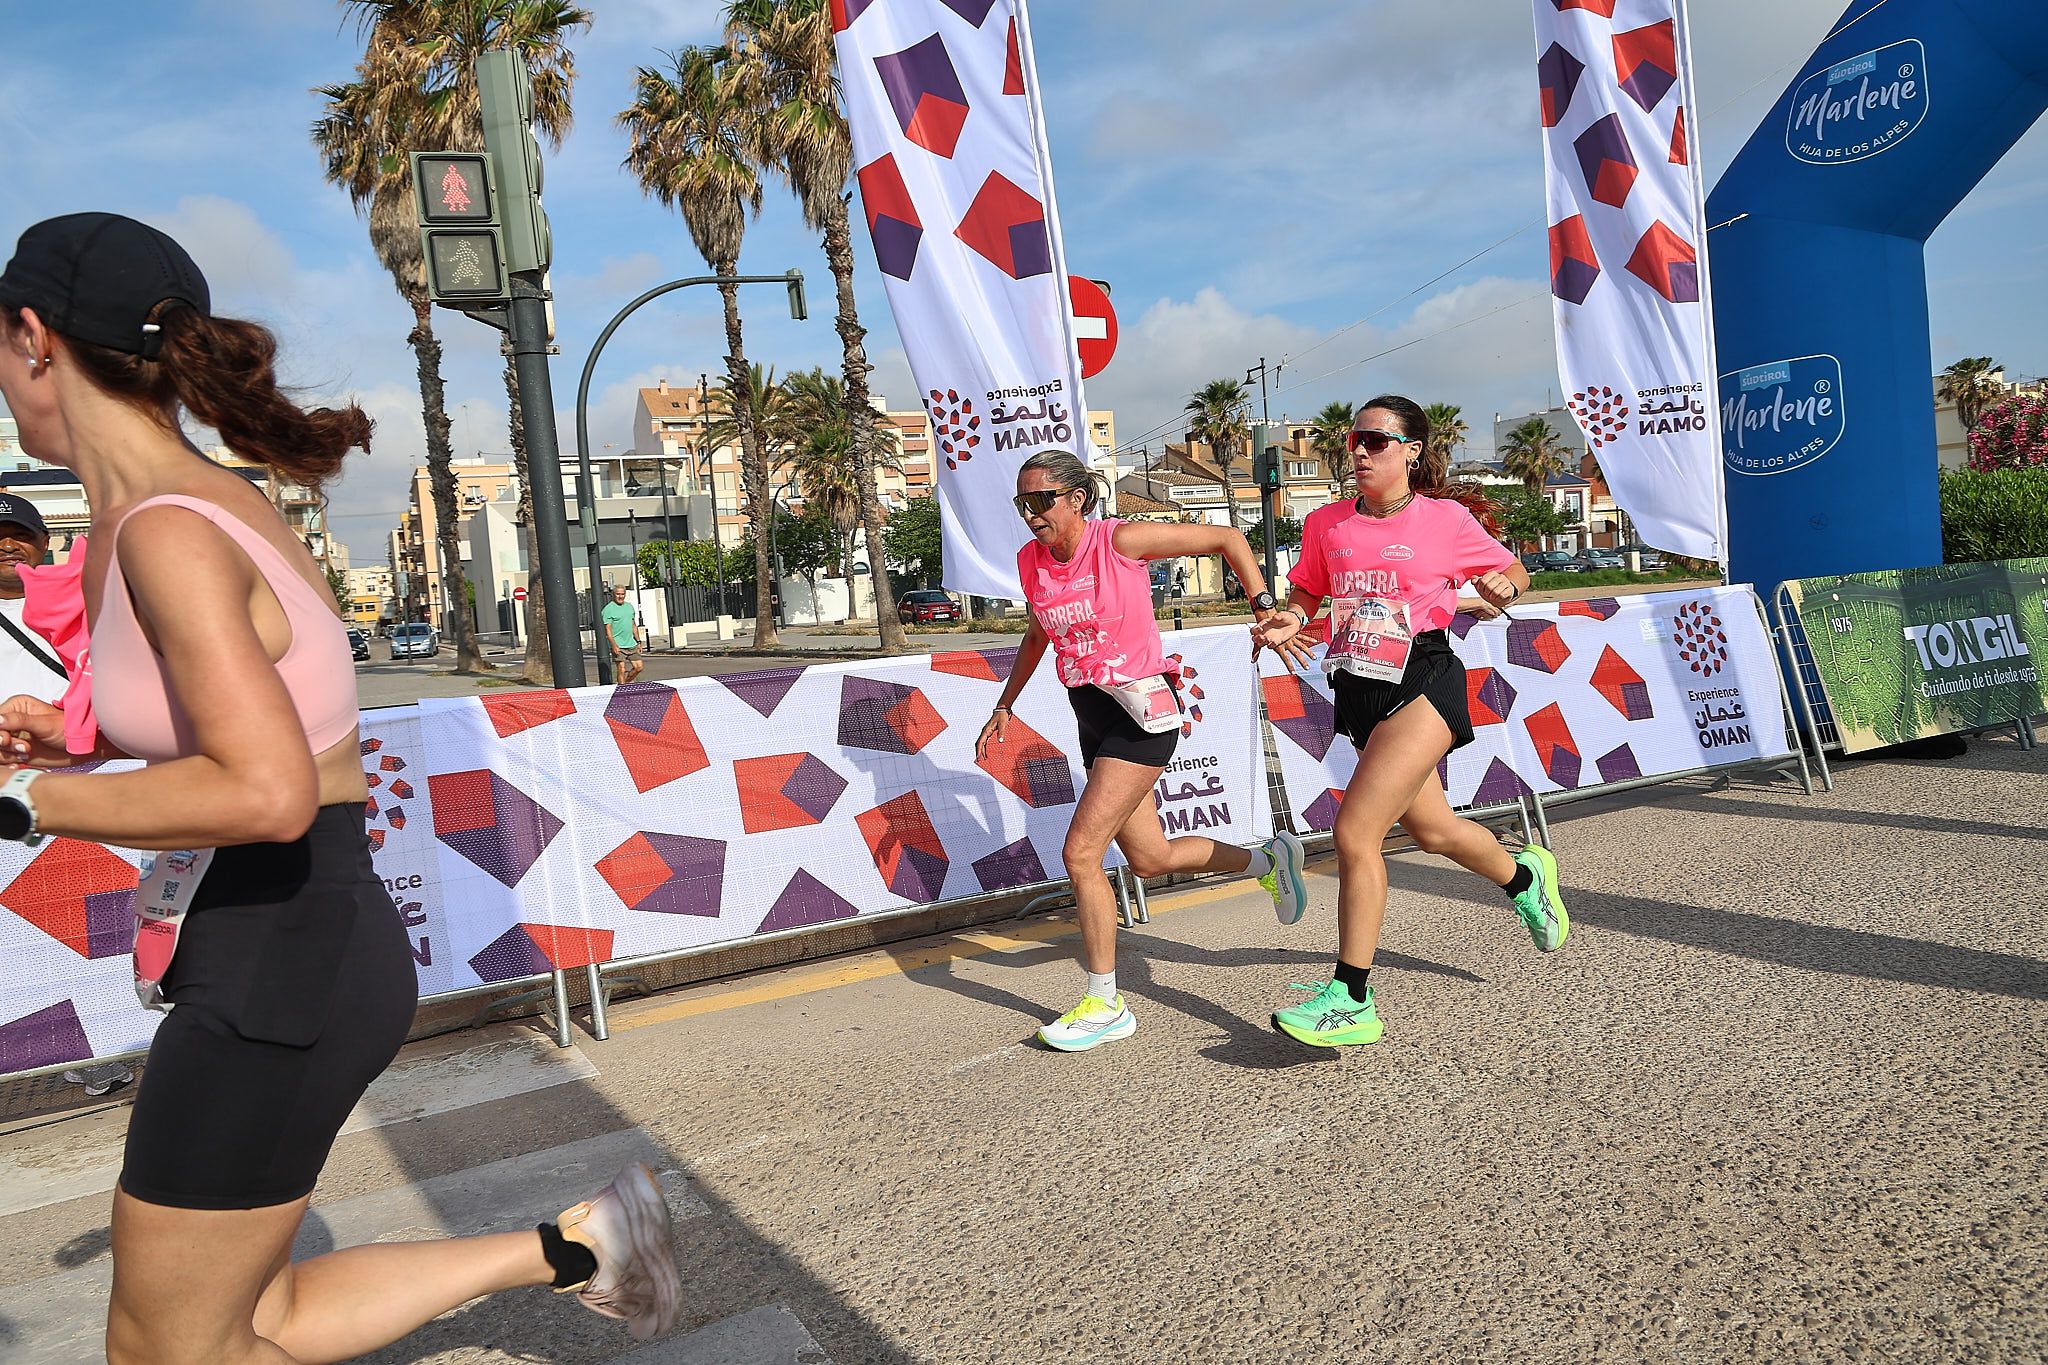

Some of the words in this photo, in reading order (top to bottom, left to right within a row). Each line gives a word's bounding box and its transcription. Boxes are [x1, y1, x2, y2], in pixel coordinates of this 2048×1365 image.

[1795, 75, 1917, 141] Marlene
[1799, 142, 1822, 157] HIJA
[1825, 148, 1842, 158] DE
[1845, 142, 1869, 156] LOS
[1873, 119, 1909, 148] ALPES
[1722, 385, 1833, 449] Marlene
[1727, 449, 1744, 466] HIJA
[1746, 458, 1759, 468] DE
[1762, 456, 1784, 468] LOS
[1788, 437, 1824, 463] ALPES
[1831, 617, 1853, 633] 1975
[1351, 646, 1369, 654] 3150
[1364, 667, 1392, 677] Santander
[1921, 675, 1971, 698] Cuidando
[1973, 672, 1985, 689] de
[1985, 671, 1994, 687] ti
[1994, 667, 2019, 685] desde
[2019, 667, 2037, 683] 1975
[1688, 687, 1740, 703] Experience
[1699, 724, 1751, 749] OMAN
[1164, 755, 1219, 774] erience
